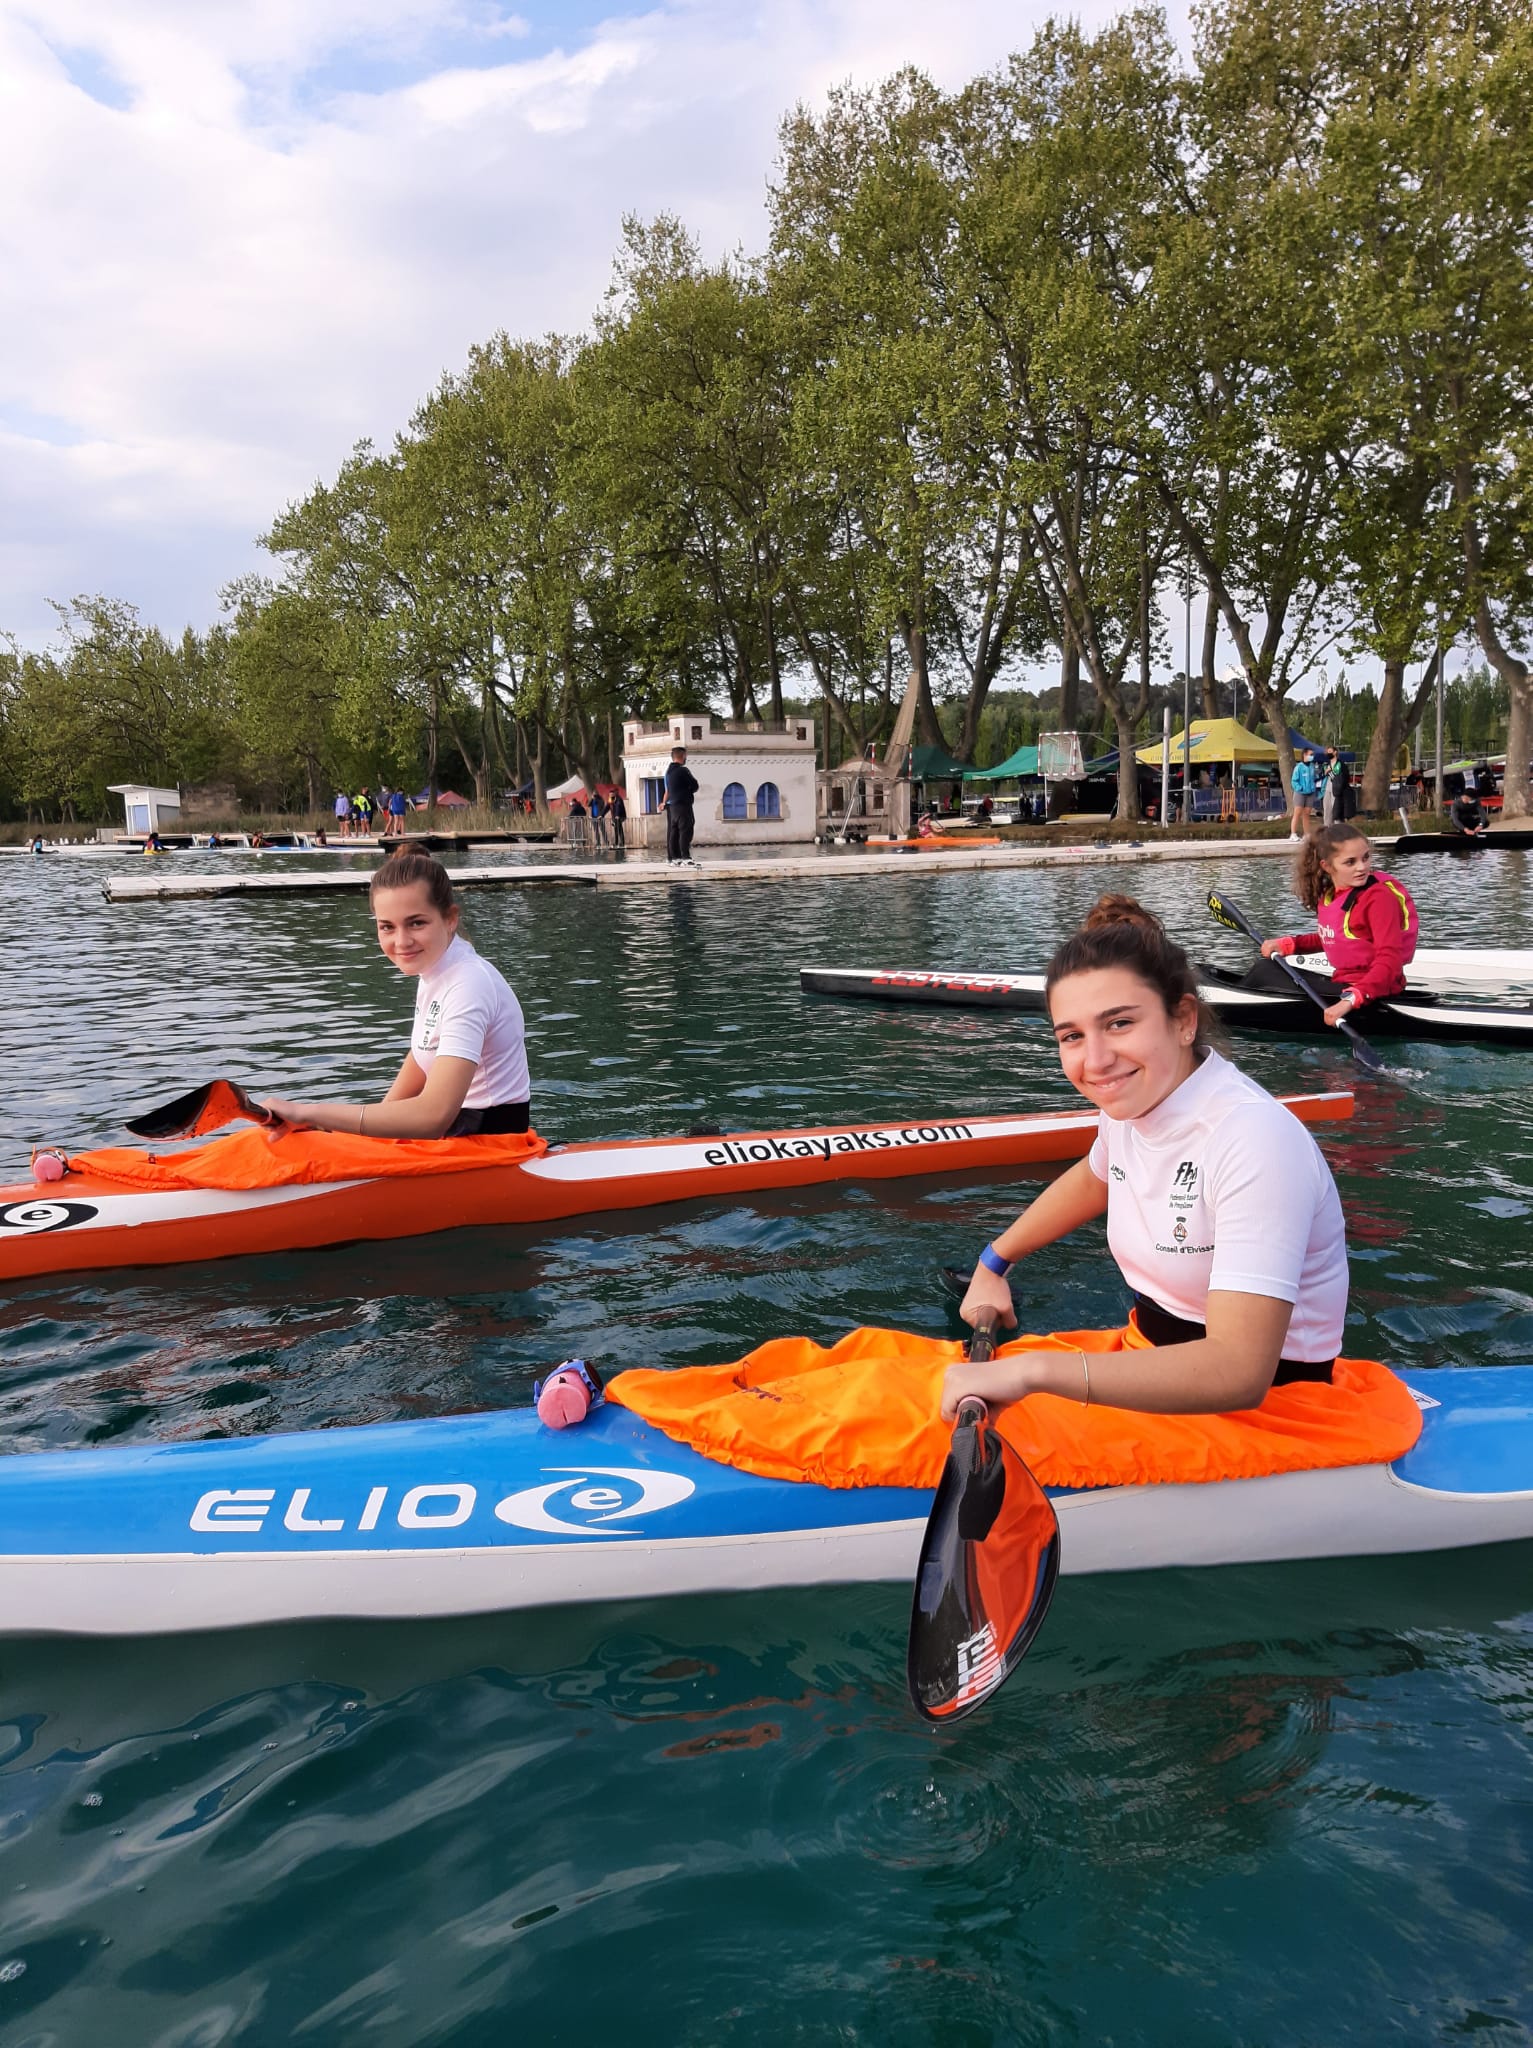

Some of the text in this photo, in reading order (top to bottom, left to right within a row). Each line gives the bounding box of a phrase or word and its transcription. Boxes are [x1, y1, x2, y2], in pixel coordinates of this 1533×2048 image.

[871, 969, 1020, 994] ZEDTECH
[704, 1124, 973, 1166] eliokayaks.com
[189, 1483, 477, 1533] ELIO
